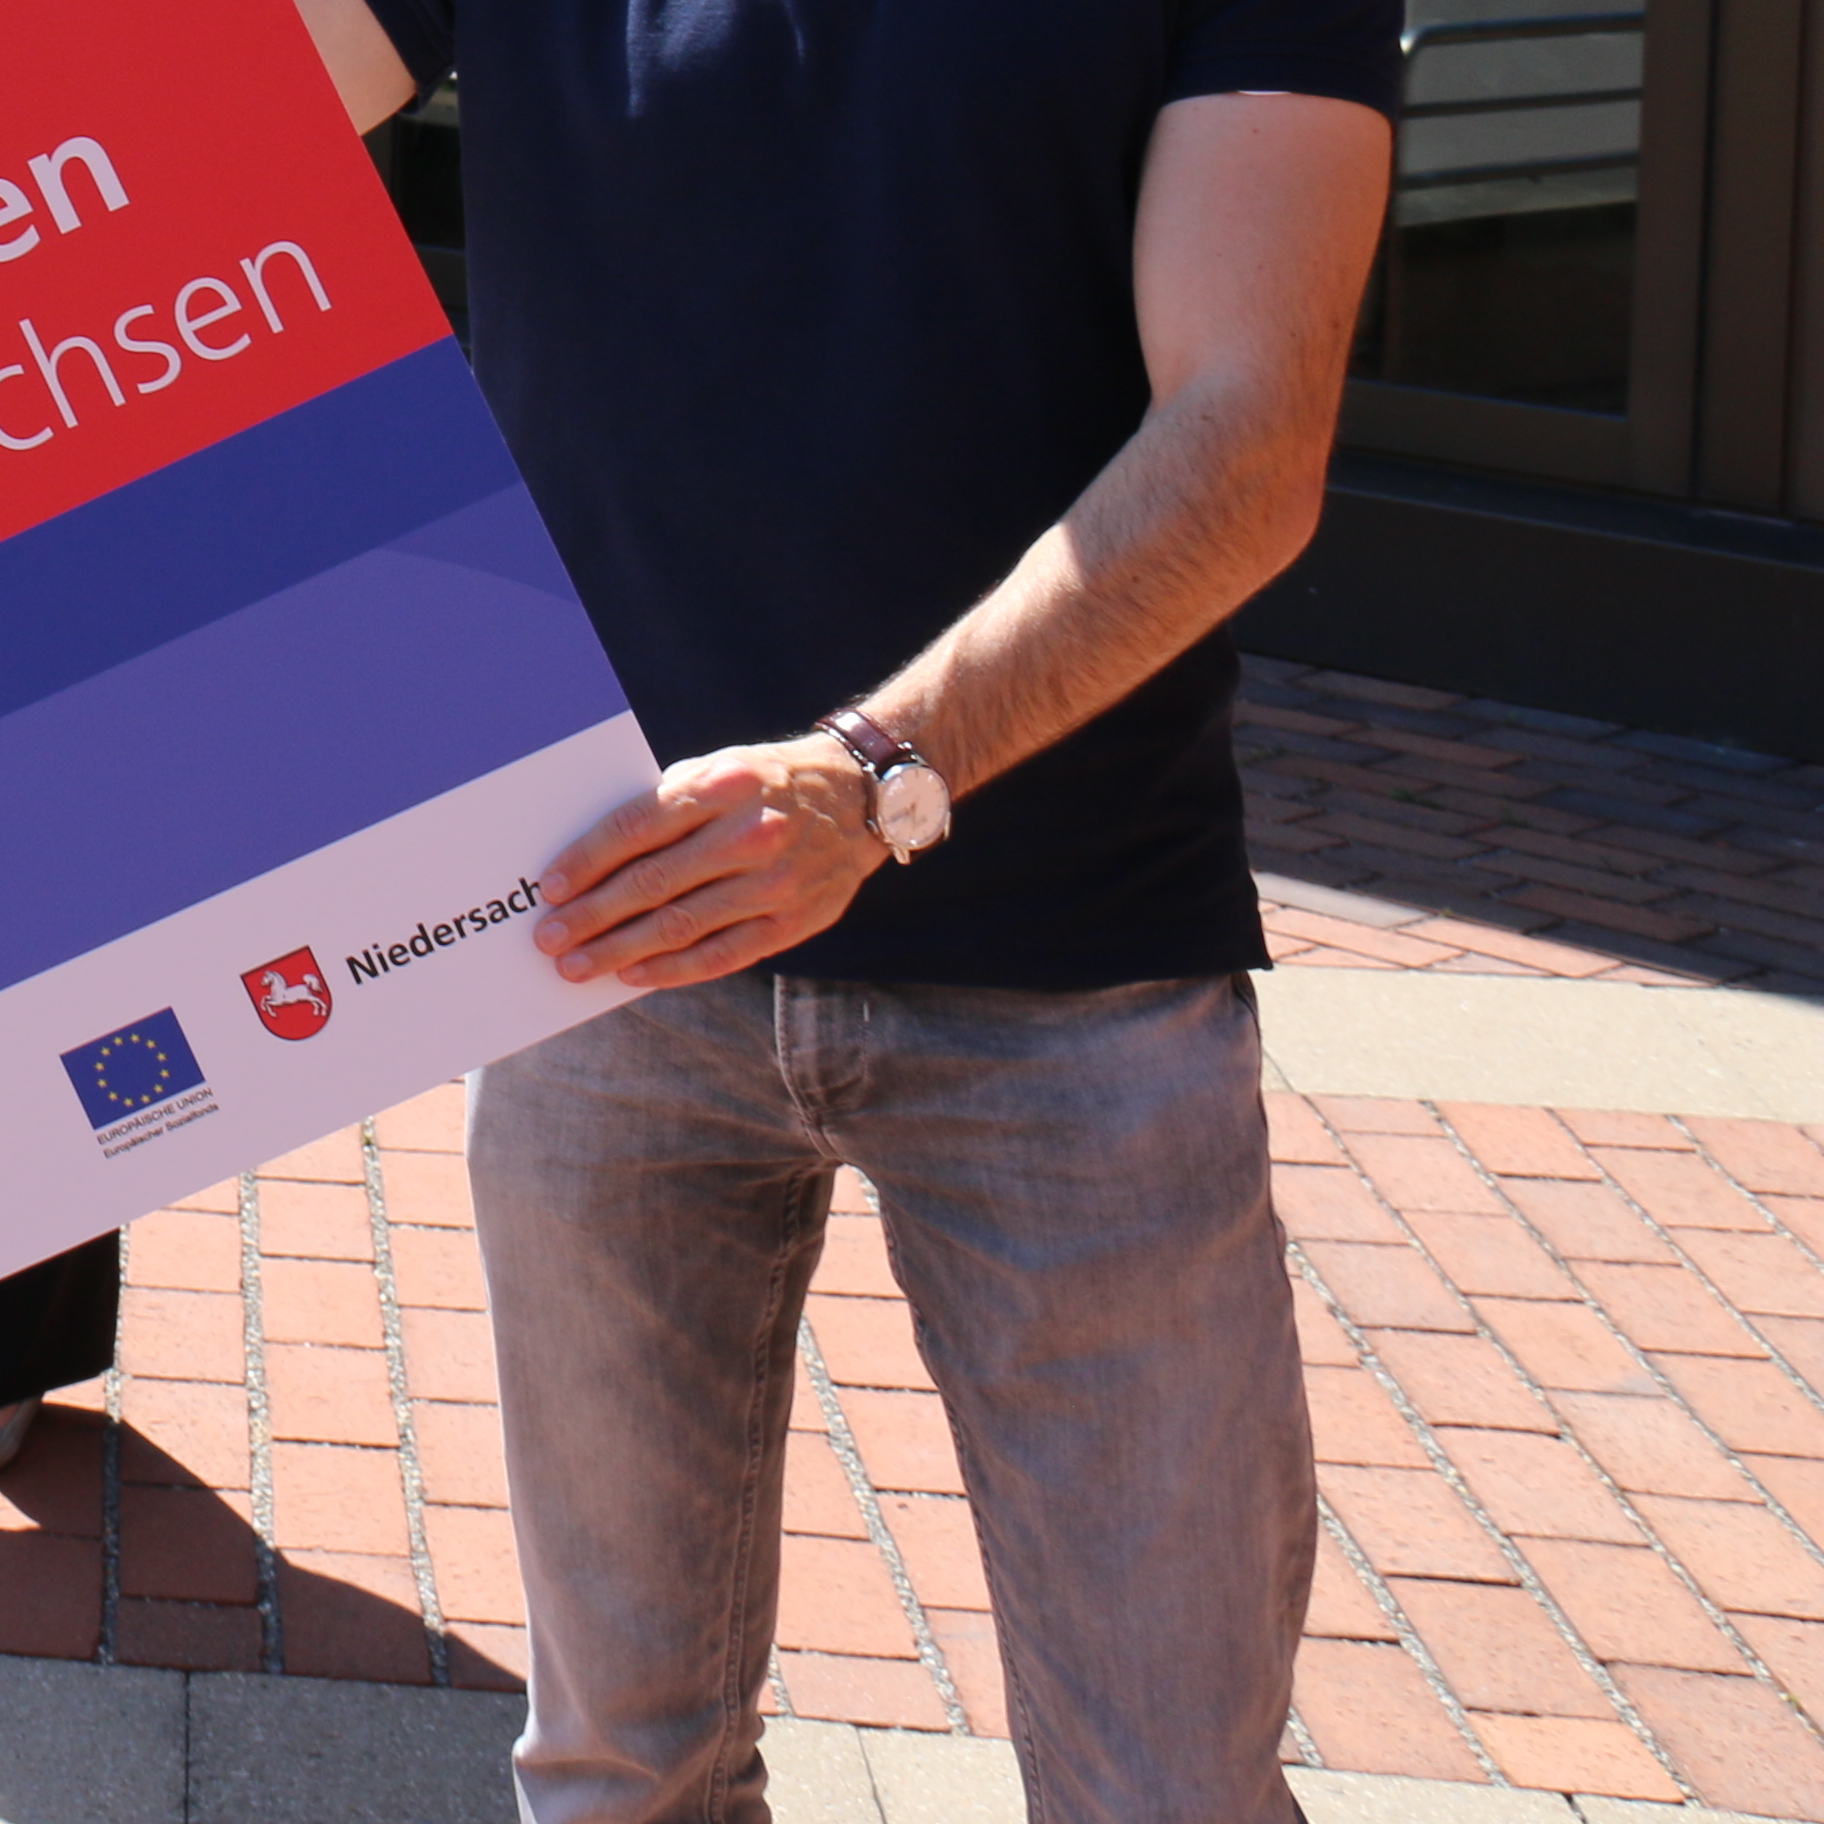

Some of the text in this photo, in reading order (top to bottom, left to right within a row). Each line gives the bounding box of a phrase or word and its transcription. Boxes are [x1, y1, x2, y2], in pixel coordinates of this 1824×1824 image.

[345, 877, 540, 985] Niedersach
[96, 1087, 214, 1145] EUROPÄISCHE UNION
